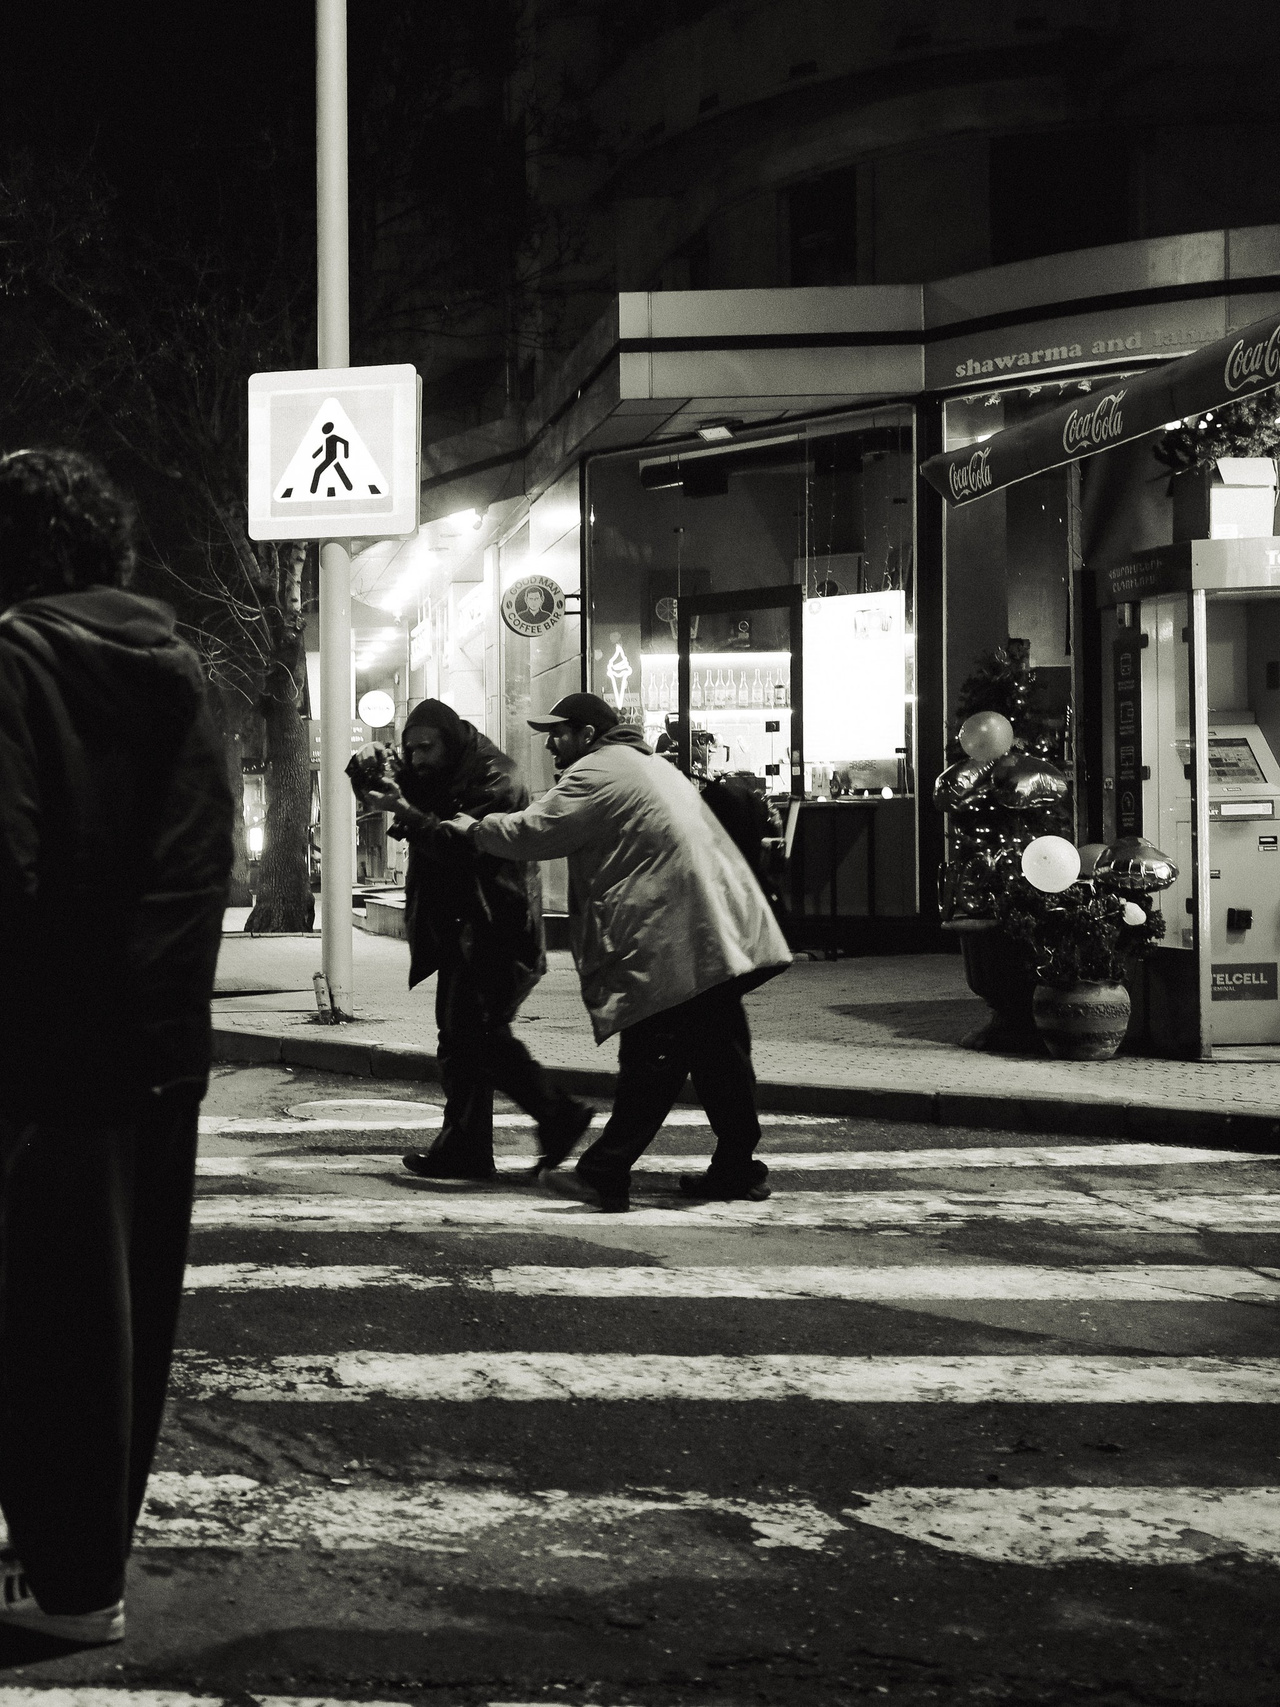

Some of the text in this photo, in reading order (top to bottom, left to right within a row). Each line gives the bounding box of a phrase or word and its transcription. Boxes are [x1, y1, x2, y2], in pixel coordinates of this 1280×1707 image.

[955, 343, 1083, 378] shawarma
[1091, 331, 1142, 354] and
[509, 576, 561, 596] GOOD MAN
[508, 612, 543, 634] COFFEE
[543, 611, 562, 631] BAR
